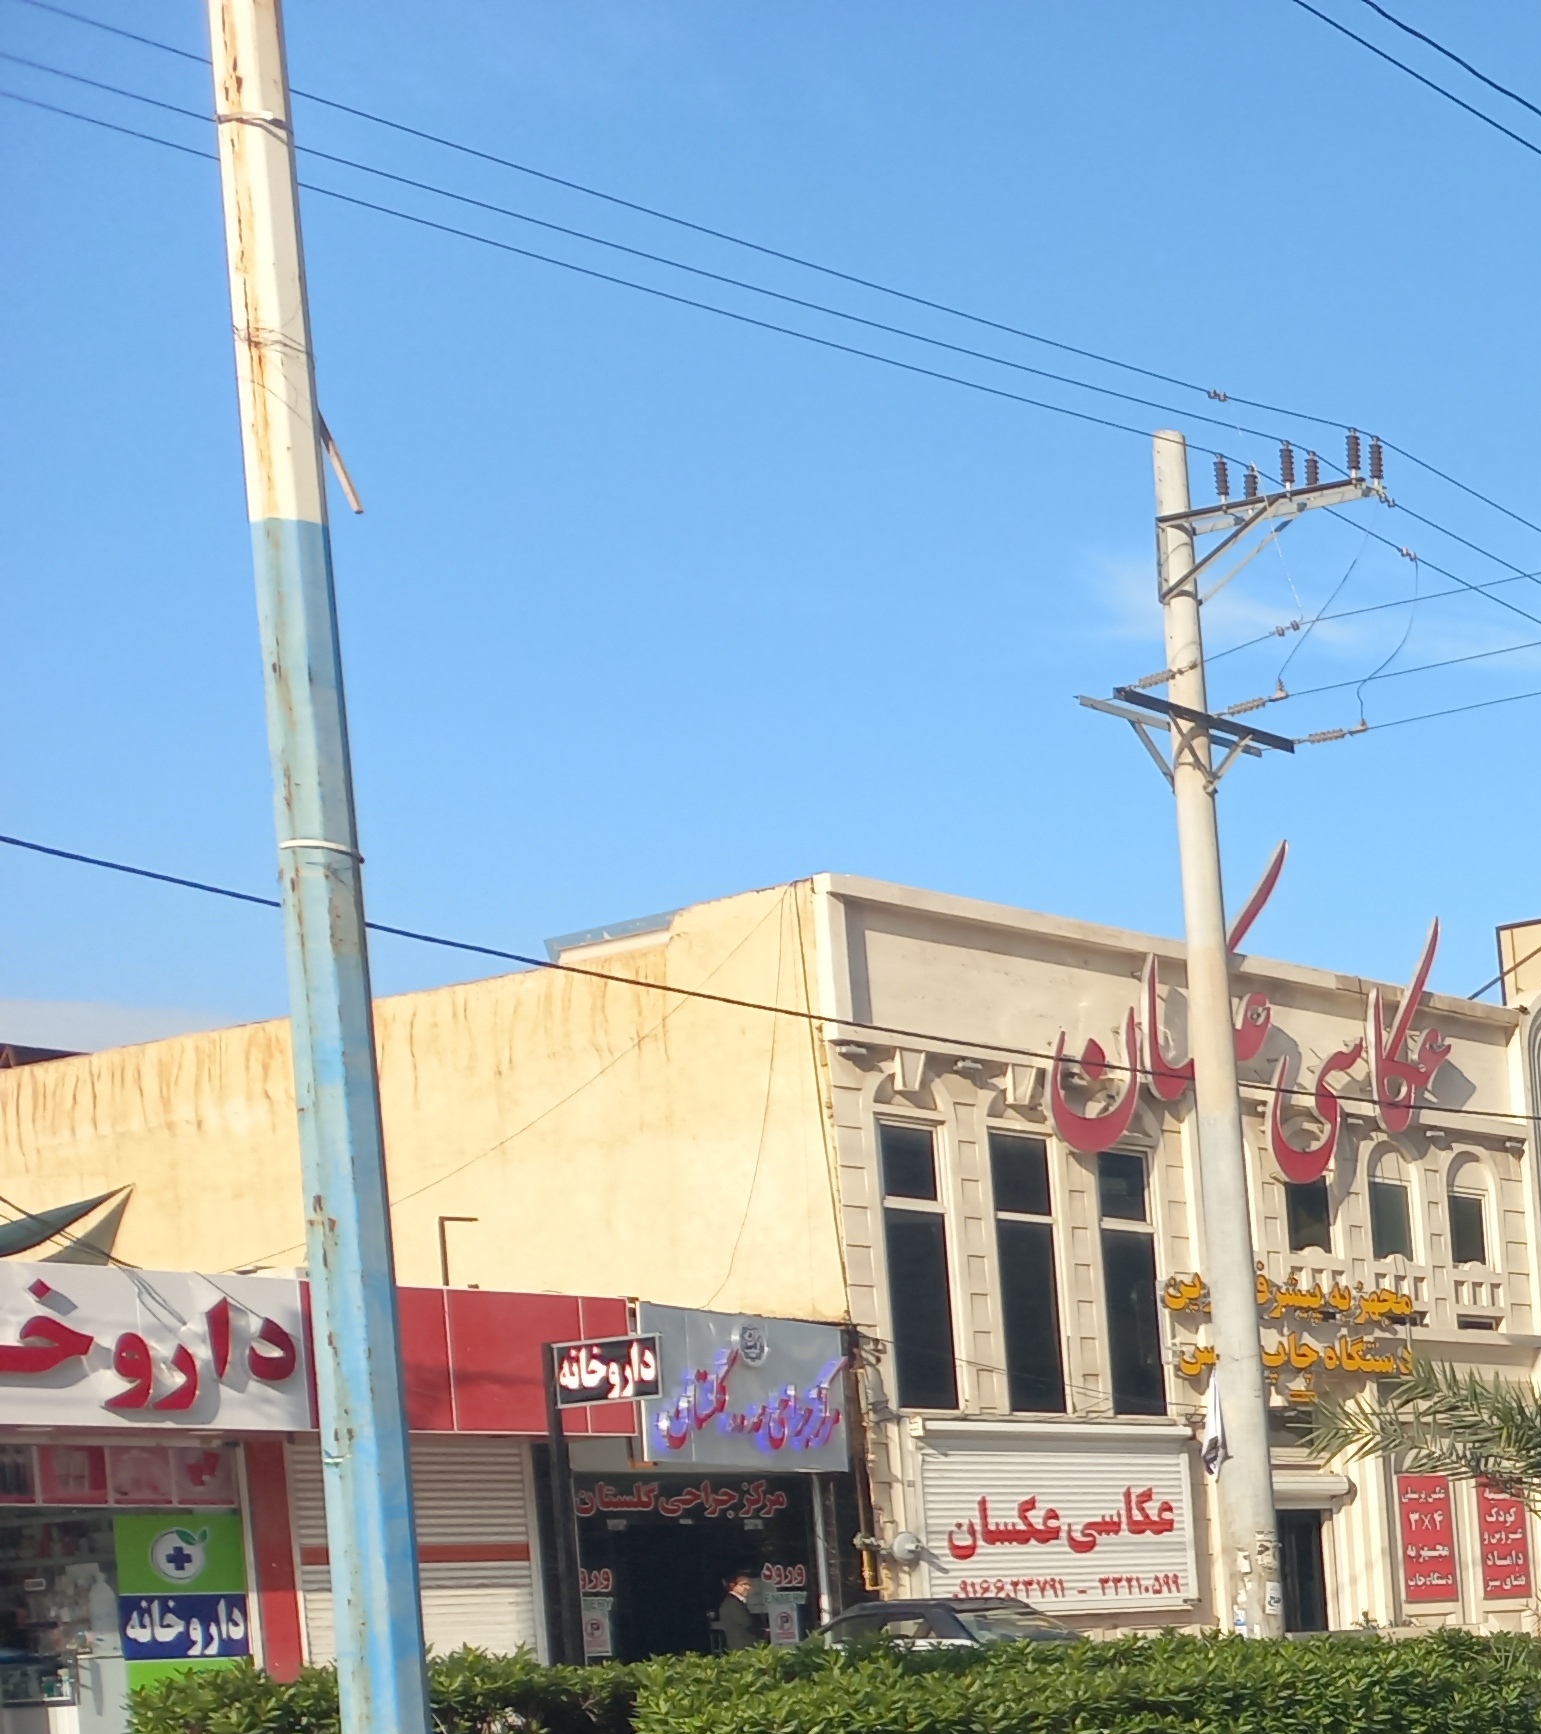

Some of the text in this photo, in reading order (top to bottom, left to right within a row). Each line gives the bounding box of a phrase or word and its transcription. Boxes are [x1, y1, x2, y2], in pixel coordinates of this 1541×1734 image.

[1045, 839, 1290, 1153] عکان
[1256, 1260, 1323, 1324] پیشرف
[0, 1277, 297, 1411] داروخ
[558, 1340, 657, 1399] داروخانه
[1261, 1331, 1320, 1384] چاپ
[574, 1480, 788, 1518] مرکز جراحی گلستان
[947, 1495, 1062, 1561] عکسان
[1066, 1485, 1175, 1554] عکاسی
[1485, 1507, 1518, 1527] کودک
[579, 1567, 613, 1593] ورو
[761, 1562, 807, 1588] ورود
[125, 1598, 246, 1656] داروخانه
